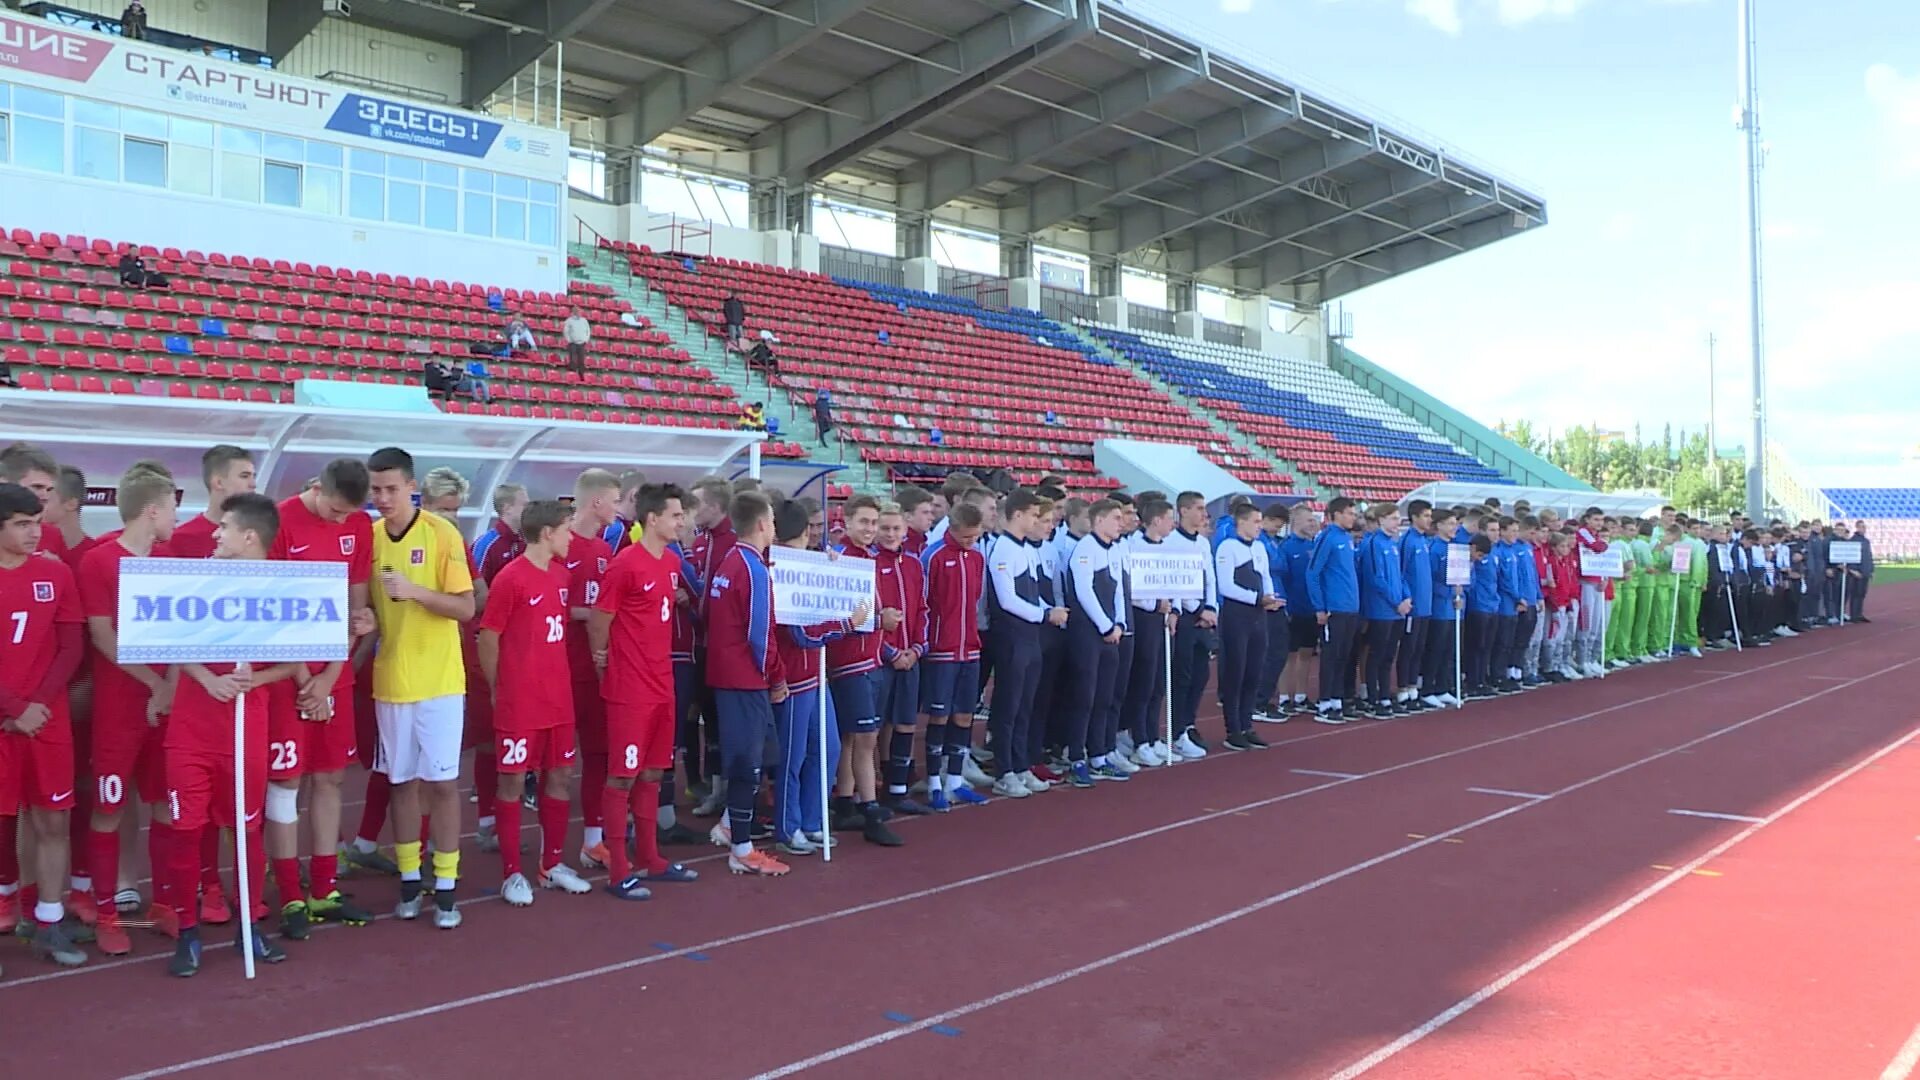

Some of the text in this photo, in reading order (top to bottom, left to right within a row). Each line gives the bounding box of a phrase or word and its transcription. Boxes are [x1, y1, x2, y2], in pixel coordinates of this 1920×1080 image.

[126, 52, 330, 109] СТАРТУЮТ
[1131, 559, 1203, 570] РОСТОВСКАЯ
[774, 568, 872, 594] МОСКОВСКАЯ
[1144, 574, 1194, 585] ОБЛАСТЬ
[133, 594, 342, 623] МОСКВА
[791, 591, 856, 612] ОБЛАСТЬ
[11, 611, 28, 644] 7
[545, 614, 564, 643] 26
[270, 740, 298, 770] 23
[502, 737, 528, 765] 26
[625, 743, 639, 770] 8
[98, 774, 123, 804] 10
